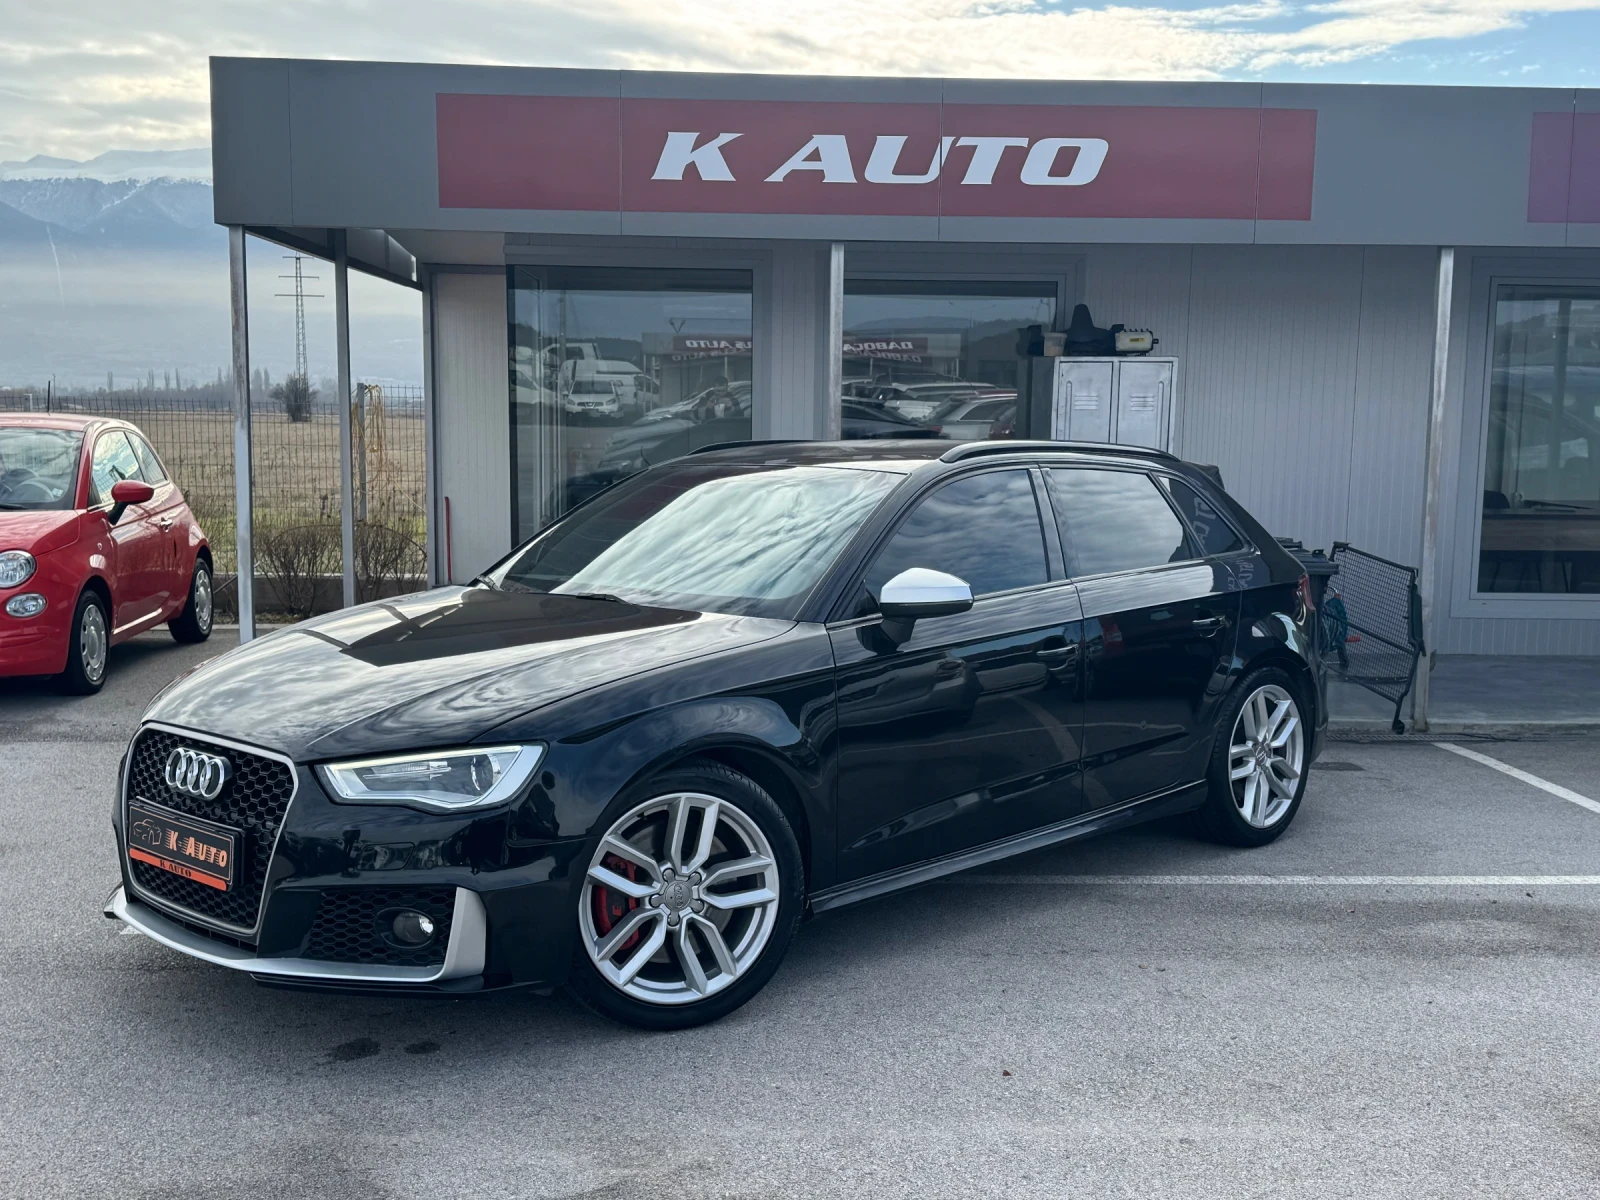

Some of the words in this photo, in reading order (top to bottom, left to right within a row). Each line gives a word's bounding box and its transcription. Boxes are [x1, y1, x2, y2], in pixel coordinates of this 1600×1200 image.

[650, 131, 745, 181] K
[763, 134, 1109, 186] AUTO
[165, 828, 179, 851] K
[182, 836, 227, 867] AUTO
[159, 860, 166, 868] K
[168, 863, 192, 878] AUTO
